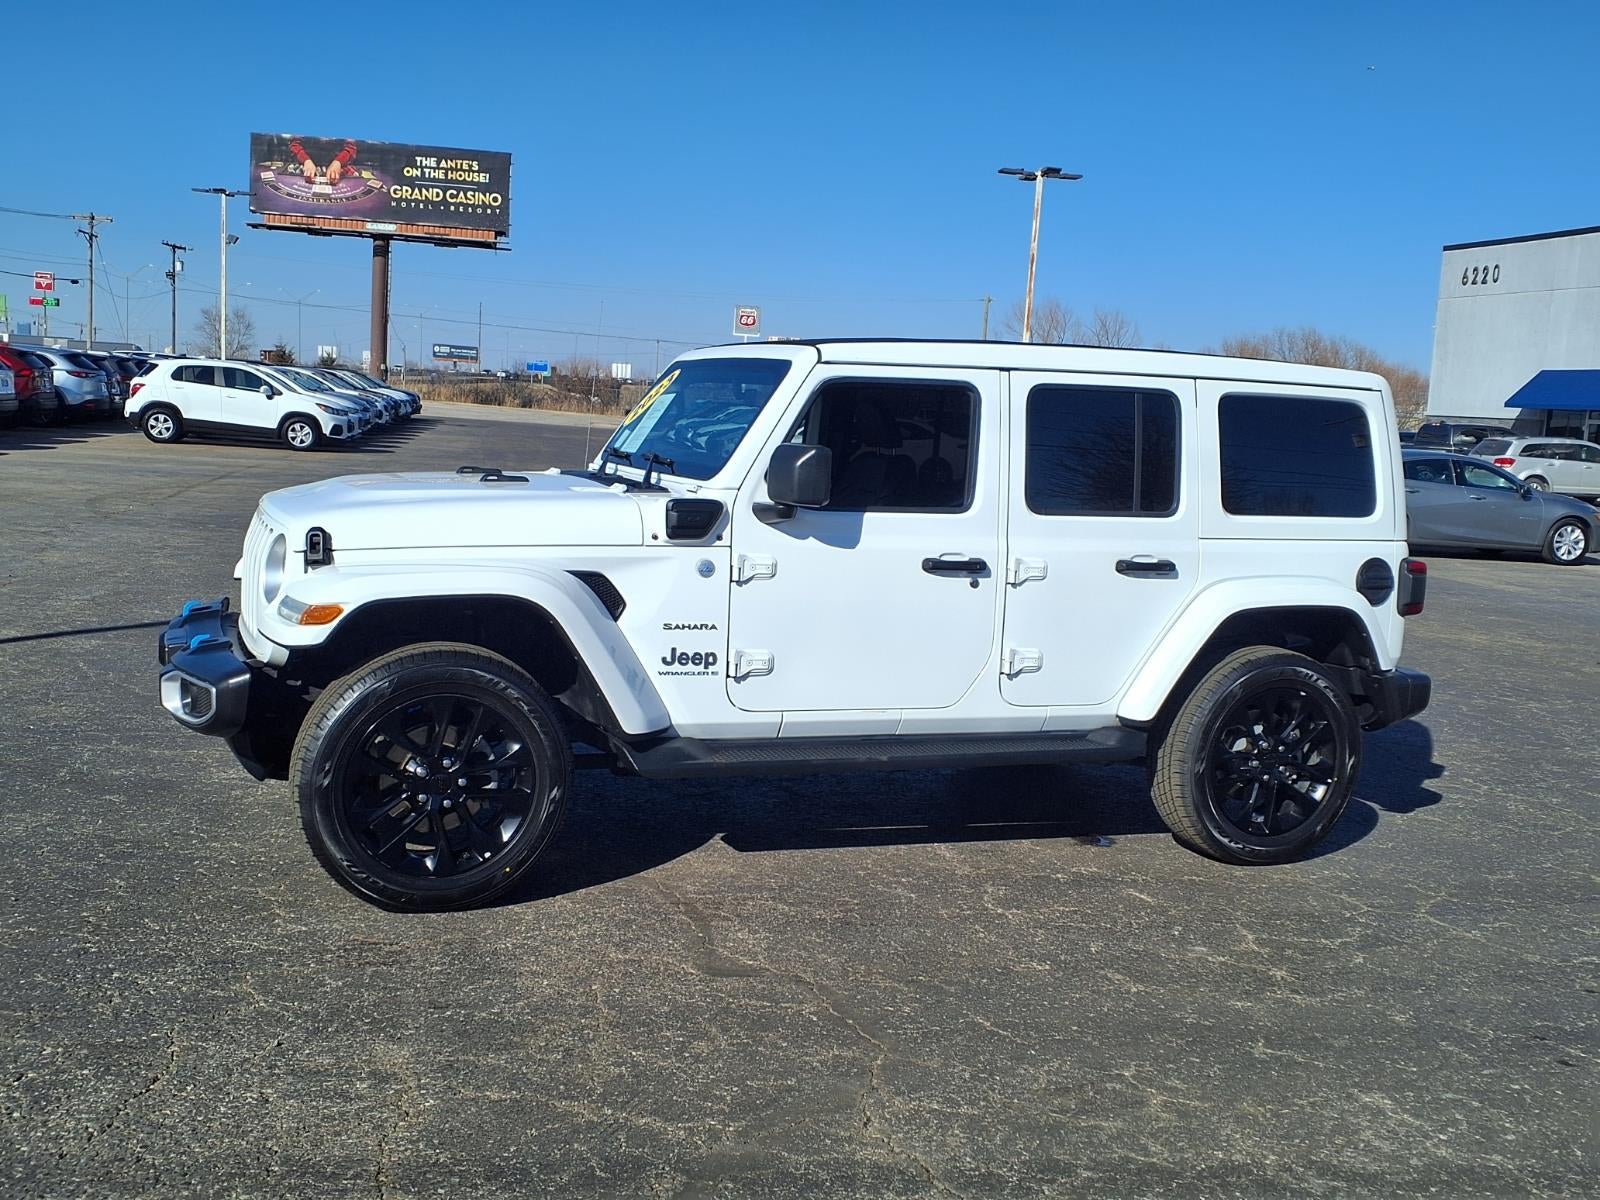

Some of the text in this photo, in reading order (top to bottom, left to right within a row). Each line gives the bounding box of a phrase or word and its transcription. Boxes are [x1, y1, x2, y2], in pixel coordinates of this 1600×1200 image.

[415, 156, 479, 171] THE ANTE'S
[403, 167, 489, 183] ON THE HOUSE!
[390, 185, 502, 206] GRAND CASINO
[391, 201, 500, 215] HOTEL RESORT
[1461, 263, 1500, 286] 6220
[740, 315, 755, 325] 66
[662, 622, 719, 631] SAHARA
[661, 646, 718, 670] Jeep
